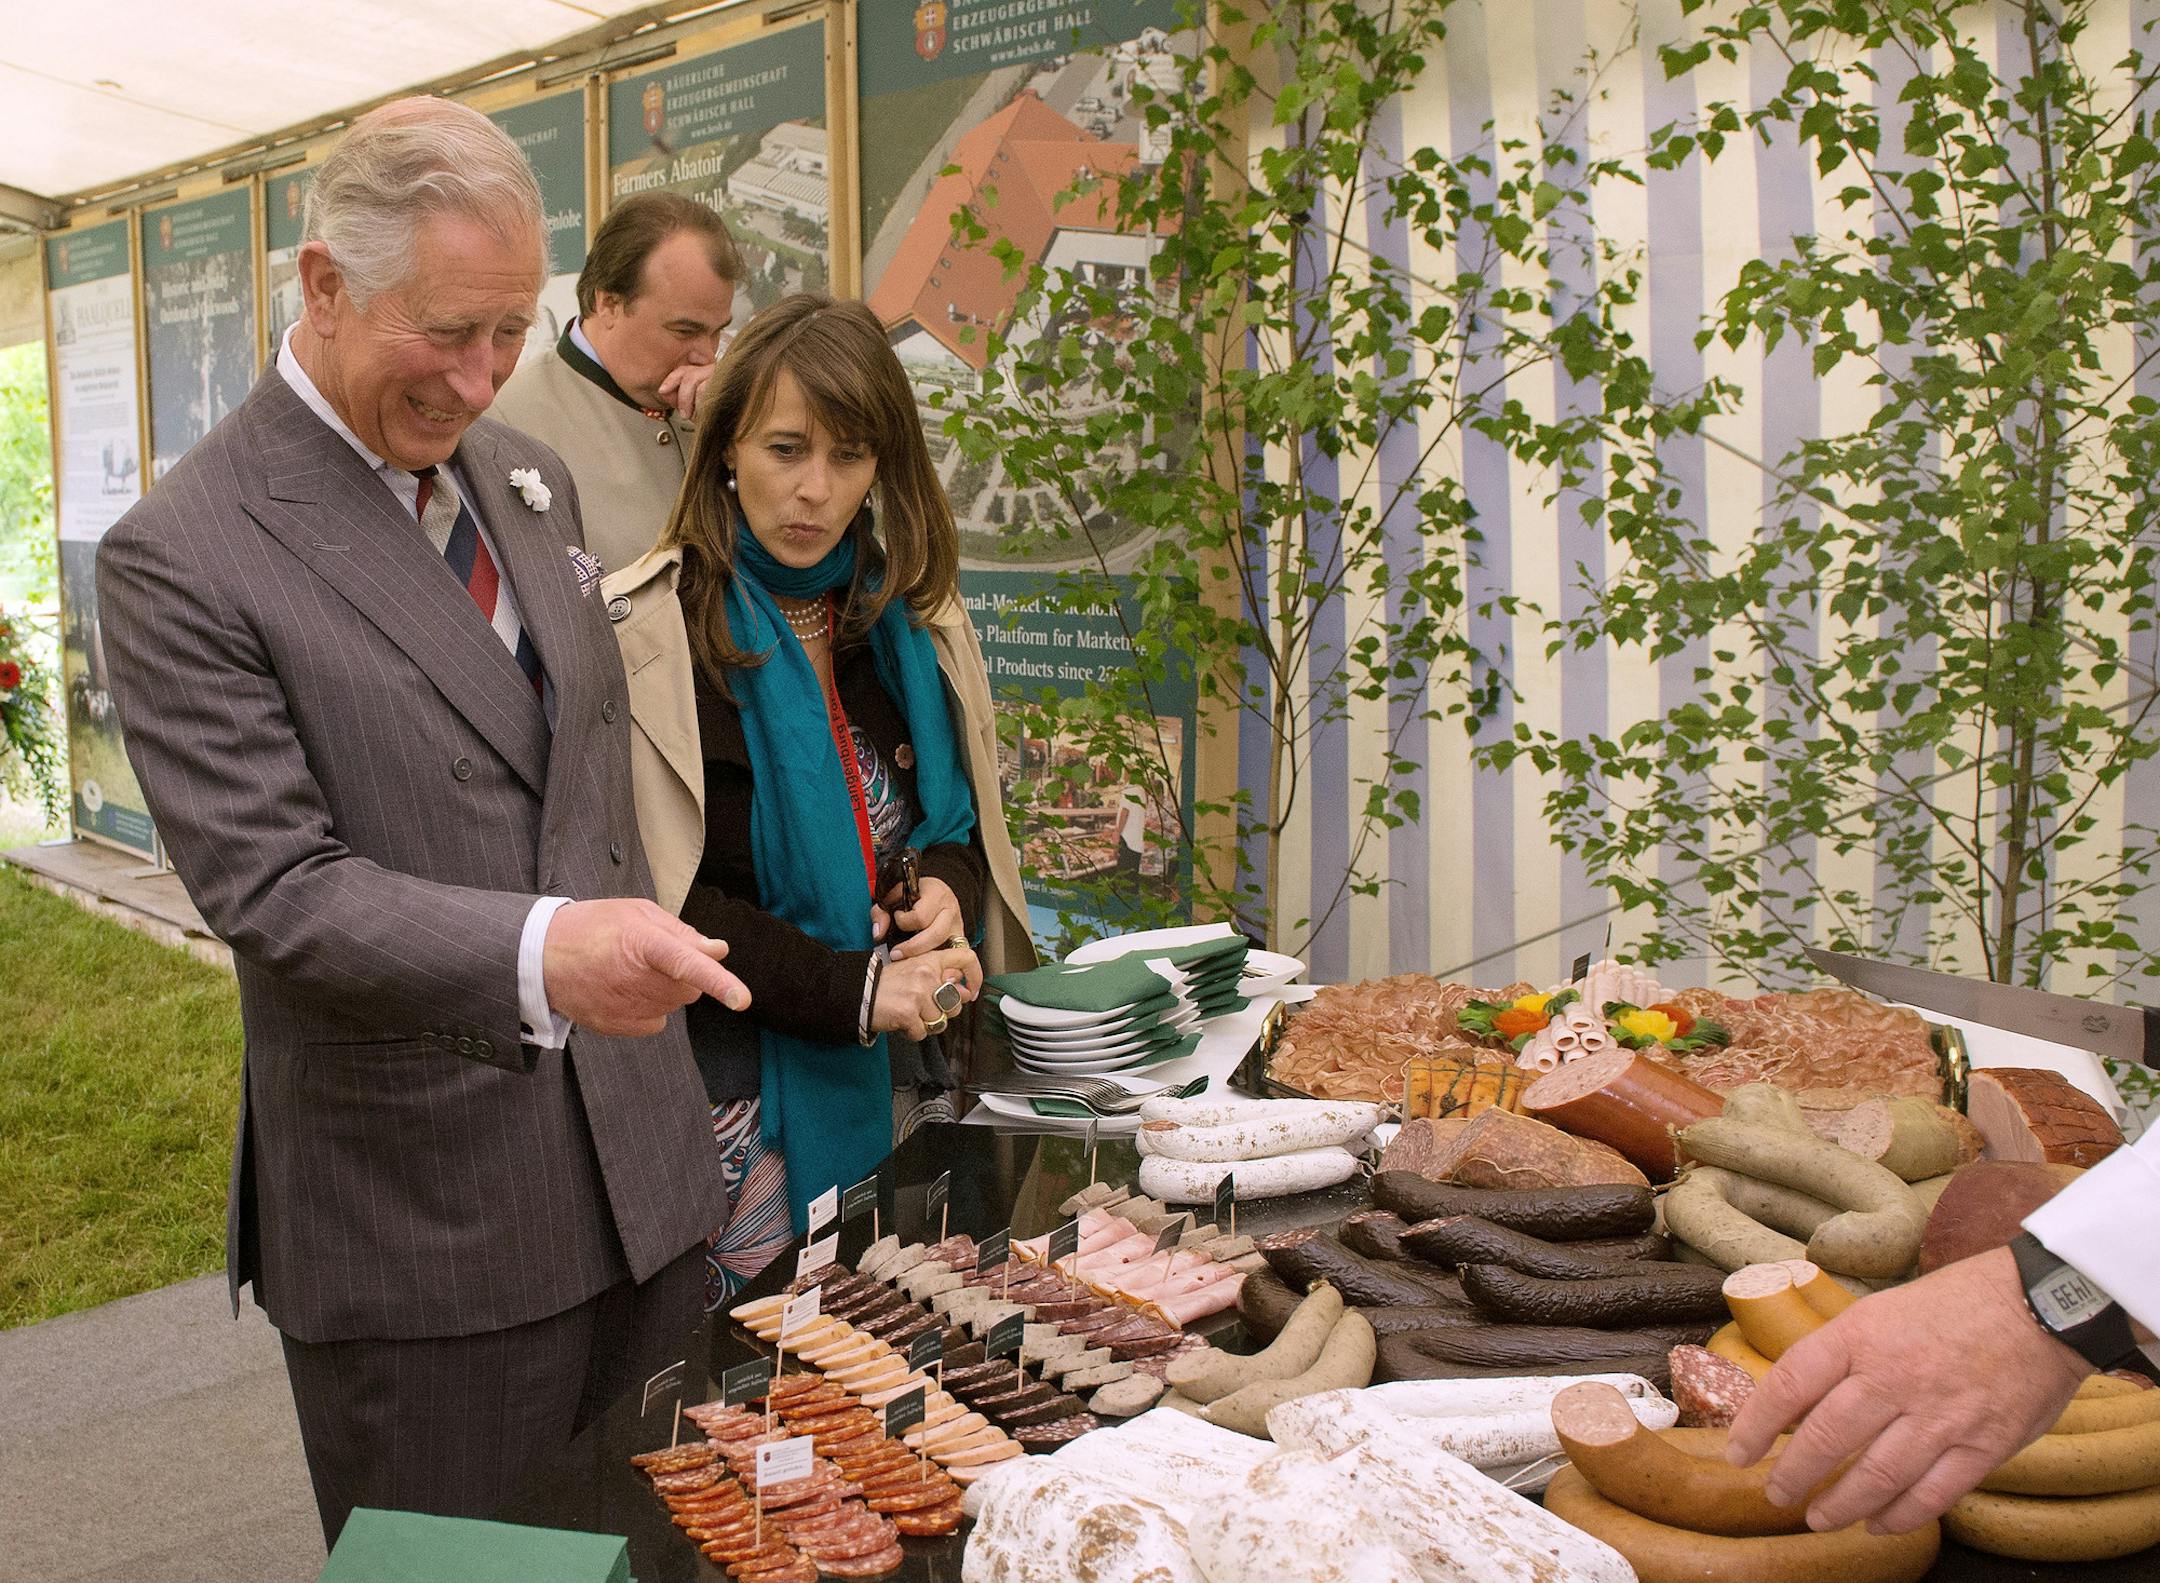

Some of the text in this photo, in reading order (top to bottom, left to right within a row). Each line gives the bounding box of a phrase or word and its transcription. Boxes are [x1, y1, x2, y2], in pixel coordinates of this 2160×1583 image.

[953, 9, 1091, 53] SCHWÄBISCH HALL
[729, 95, 755, 114] HALL
[613, 149, 724, 197] Farmers Abatoir
[986, 624, 1048, 646] Platform
[1053, 628, 1074, 648] for
[997, 656, 1054, 678] Products
[1058, 662, 1093, 680] since
[837, 723, 862, 812] Langenburg
